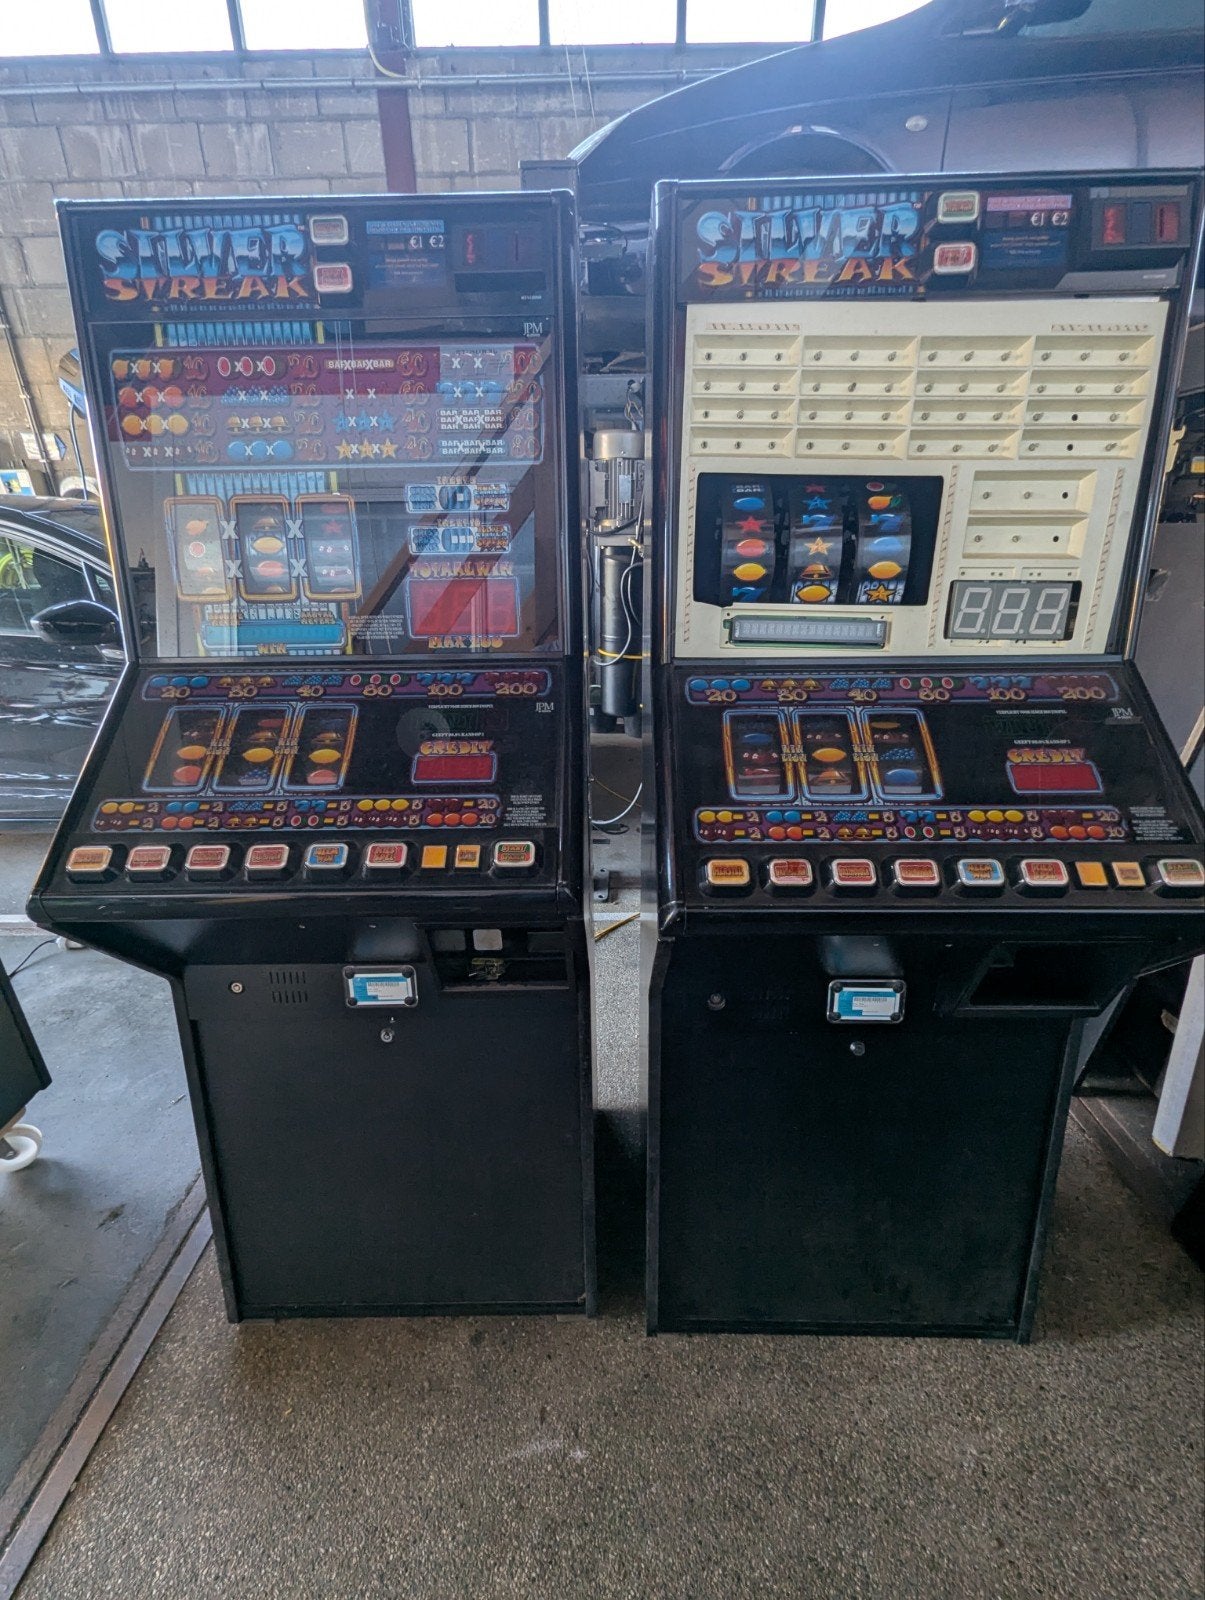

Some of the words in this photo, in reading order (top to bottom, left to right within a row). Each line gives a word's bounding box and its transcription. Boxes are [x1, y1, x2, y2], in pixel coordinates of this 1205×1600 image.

[1031, 213, 1044, 226] €1
[1052, 212, 1067, 225] €2
[698, 203, 918, 262] SILVER
[410, 235, 423, 248] €1
[430, 235, 443, 248] €2
[96, 225, 307, 278] SILVER
[698, 258, 914, 285] STREAK
[104, 277, 309, 301] STREAK
[523, 322, 542, 336] JPM
[161, 686, 191, 698] 20
[363, 684, 392, 696] 80
[428, 684, 463, 695] 100
[496, 683, 538, 695] 200
[706, 690, 737, 702] 20
[848, 689, 877, 701] 40
[989, 687, 1025, 700] 100
[1057, 687, 1106, 700] 200
[536, 702, 554, 711] JPM
[1112, 708, 1133, 717] JPM
[420, 740, 493, 755] CREDIT
[1007, 748, 1086, 763] CREDIT
